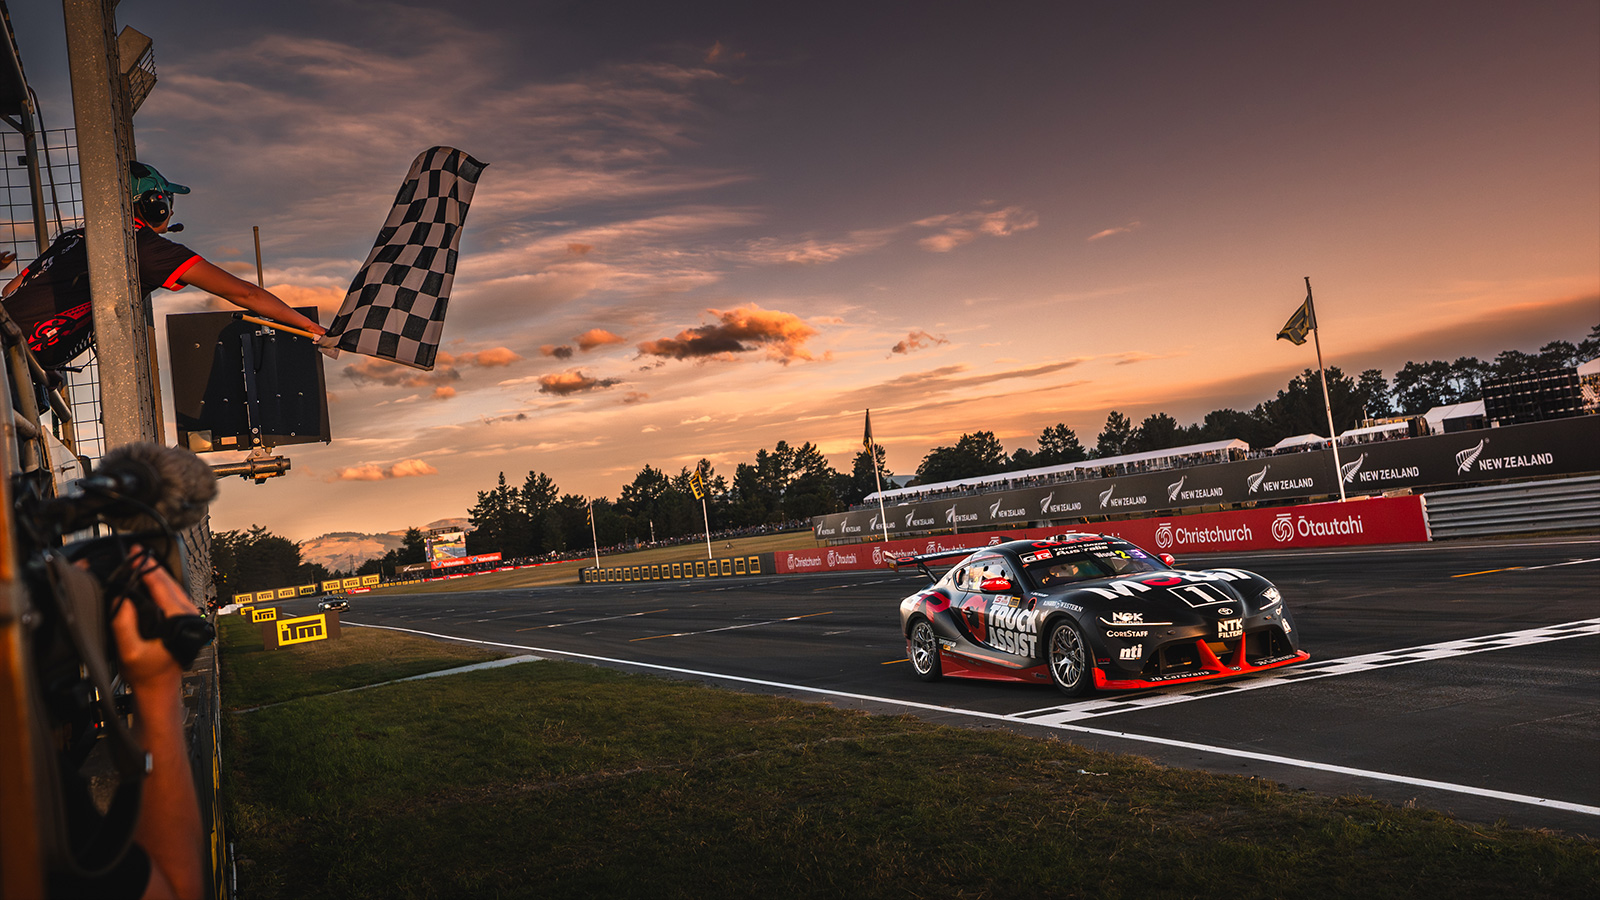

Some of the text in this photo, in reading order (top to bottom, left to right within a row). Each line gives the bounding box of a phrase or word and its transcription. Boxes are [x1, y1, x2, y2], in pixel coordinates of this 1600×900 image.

[1479, 452, 1554, 471] NEW ZEALAND
[1359, 466, 1420, 482] NEW ZEALAND
[1263, 477, 1313, 492] NEW ZEALAND
[1110, 495, 1147, 507] NEW ZEALAND
[1181, 487, 1223, 500] NEW ZEALAND
[998, 508, 1025, 518] NEW ZEALAND
[1050, 502, 1081, 513] NEW ZEALAND
[1175, 523, 1253, 545] Christchurch
[1297, 515, 1364, 538] Ōtautahi
[1114, 549, 1131, 559] 2
[794, 556, 822, 568] Christchurch
[1184, 585, 1216, 603] 1
[988, 604, 1040, 633] TRUCK
[1112, 611, 1144, 621] NGK
[1217, 617, 1243, 632] NTK
[988, 626, 1038, 659] ASSIST
[1119, 643, 1143, 659] nti
[1163, 670, 1210, 680] Caravans
